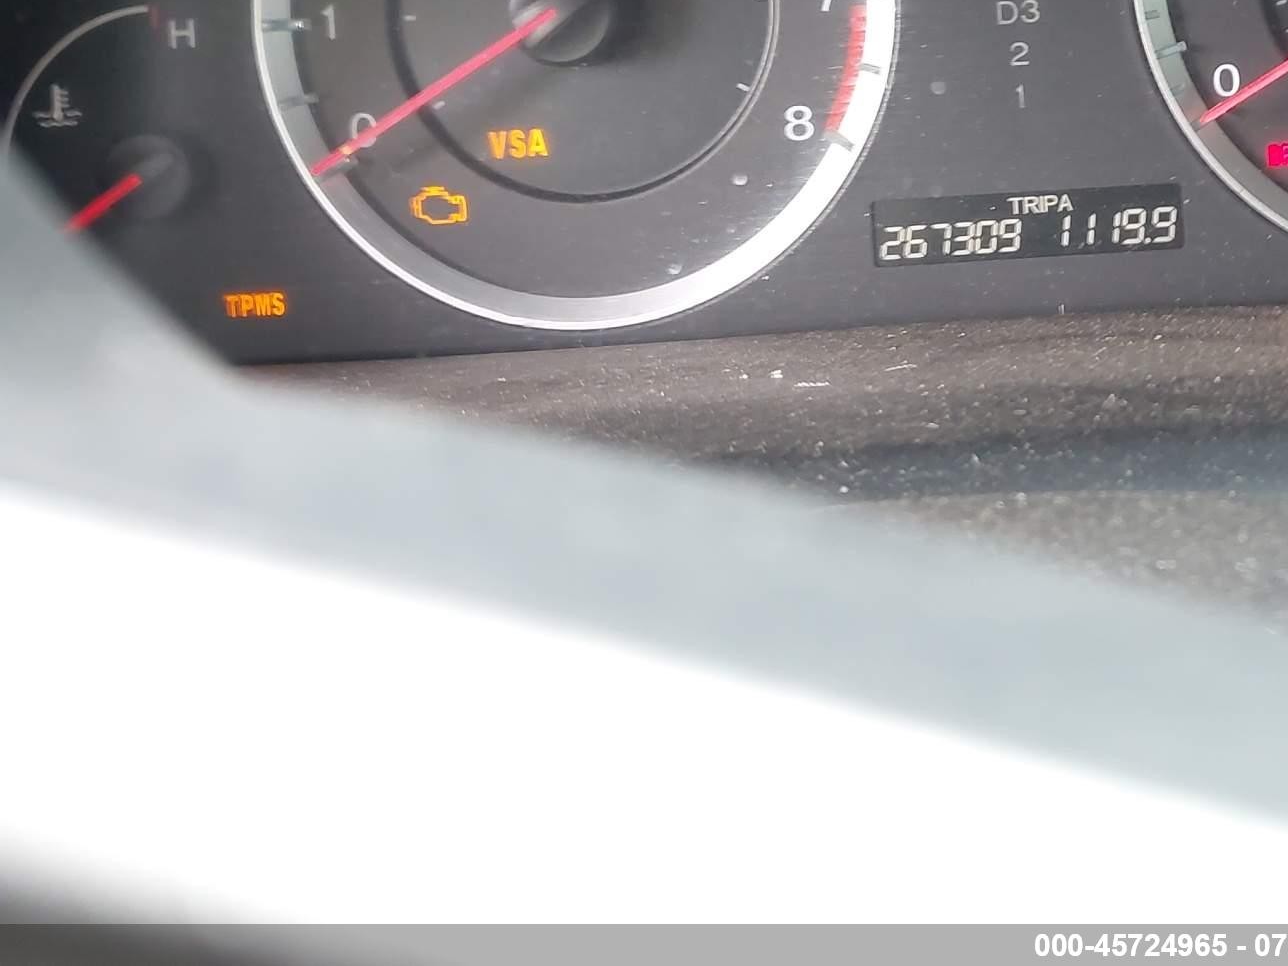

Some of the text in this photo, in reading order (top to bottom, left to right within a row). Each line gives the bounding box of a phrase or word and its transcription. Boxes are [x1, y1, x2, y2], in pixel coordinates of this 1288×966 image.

[321, 7, 336, 40] 1
[996, 0, 1040, 25] D3
[169, 19, 195, 48] H
[1010, 42, 1030, 66] 2
[1213, 63, 1240, 96] 0
[1016, 85, 1027, 108] 1
[351, 112, 377, 148] 0
[784, 106, 814, 140] 8
[488, 130, 548, 159] VSA
[879, 218, 1022, 260] 267309
[224, 291, 286, 318] TPMS
